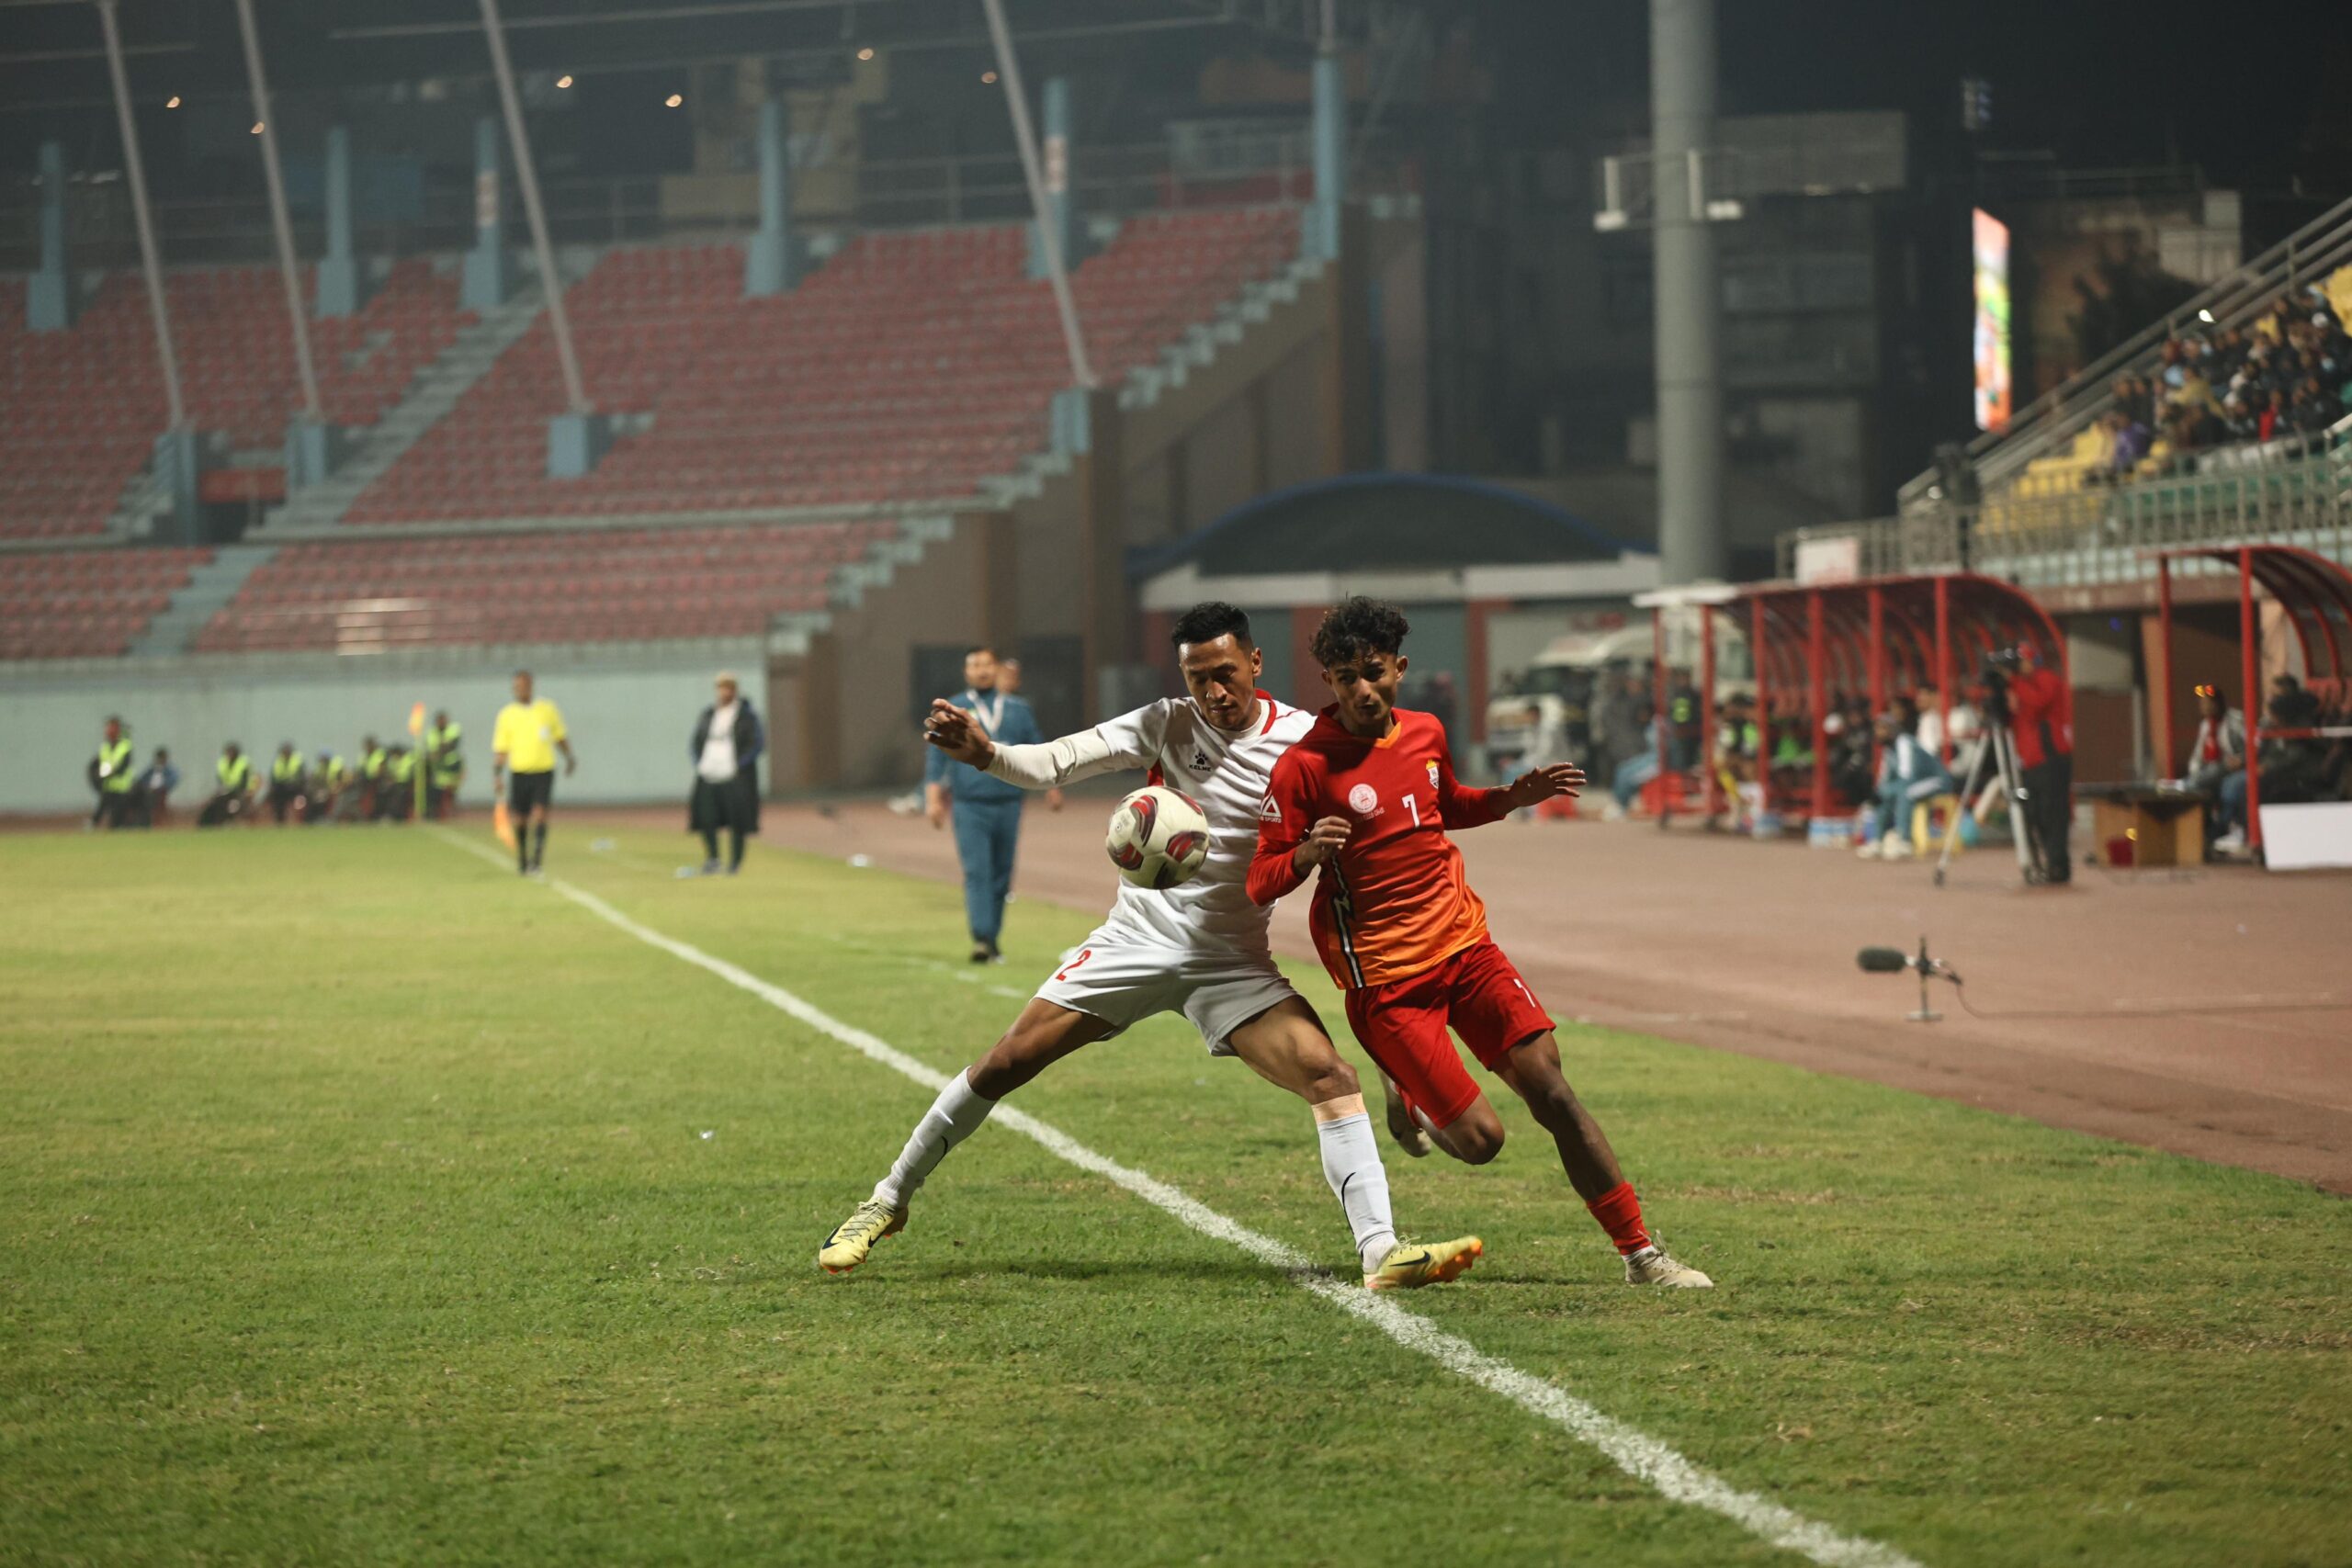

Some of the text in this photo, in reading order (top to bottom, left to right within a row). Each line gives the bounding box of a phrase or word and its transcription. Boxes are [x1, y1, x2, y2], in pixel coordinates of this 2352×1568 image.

[1188, 763, 1212, 772] KELME
[1401, 793, 1420, 828] 7
[1055, 949, 1091, 982] 2
